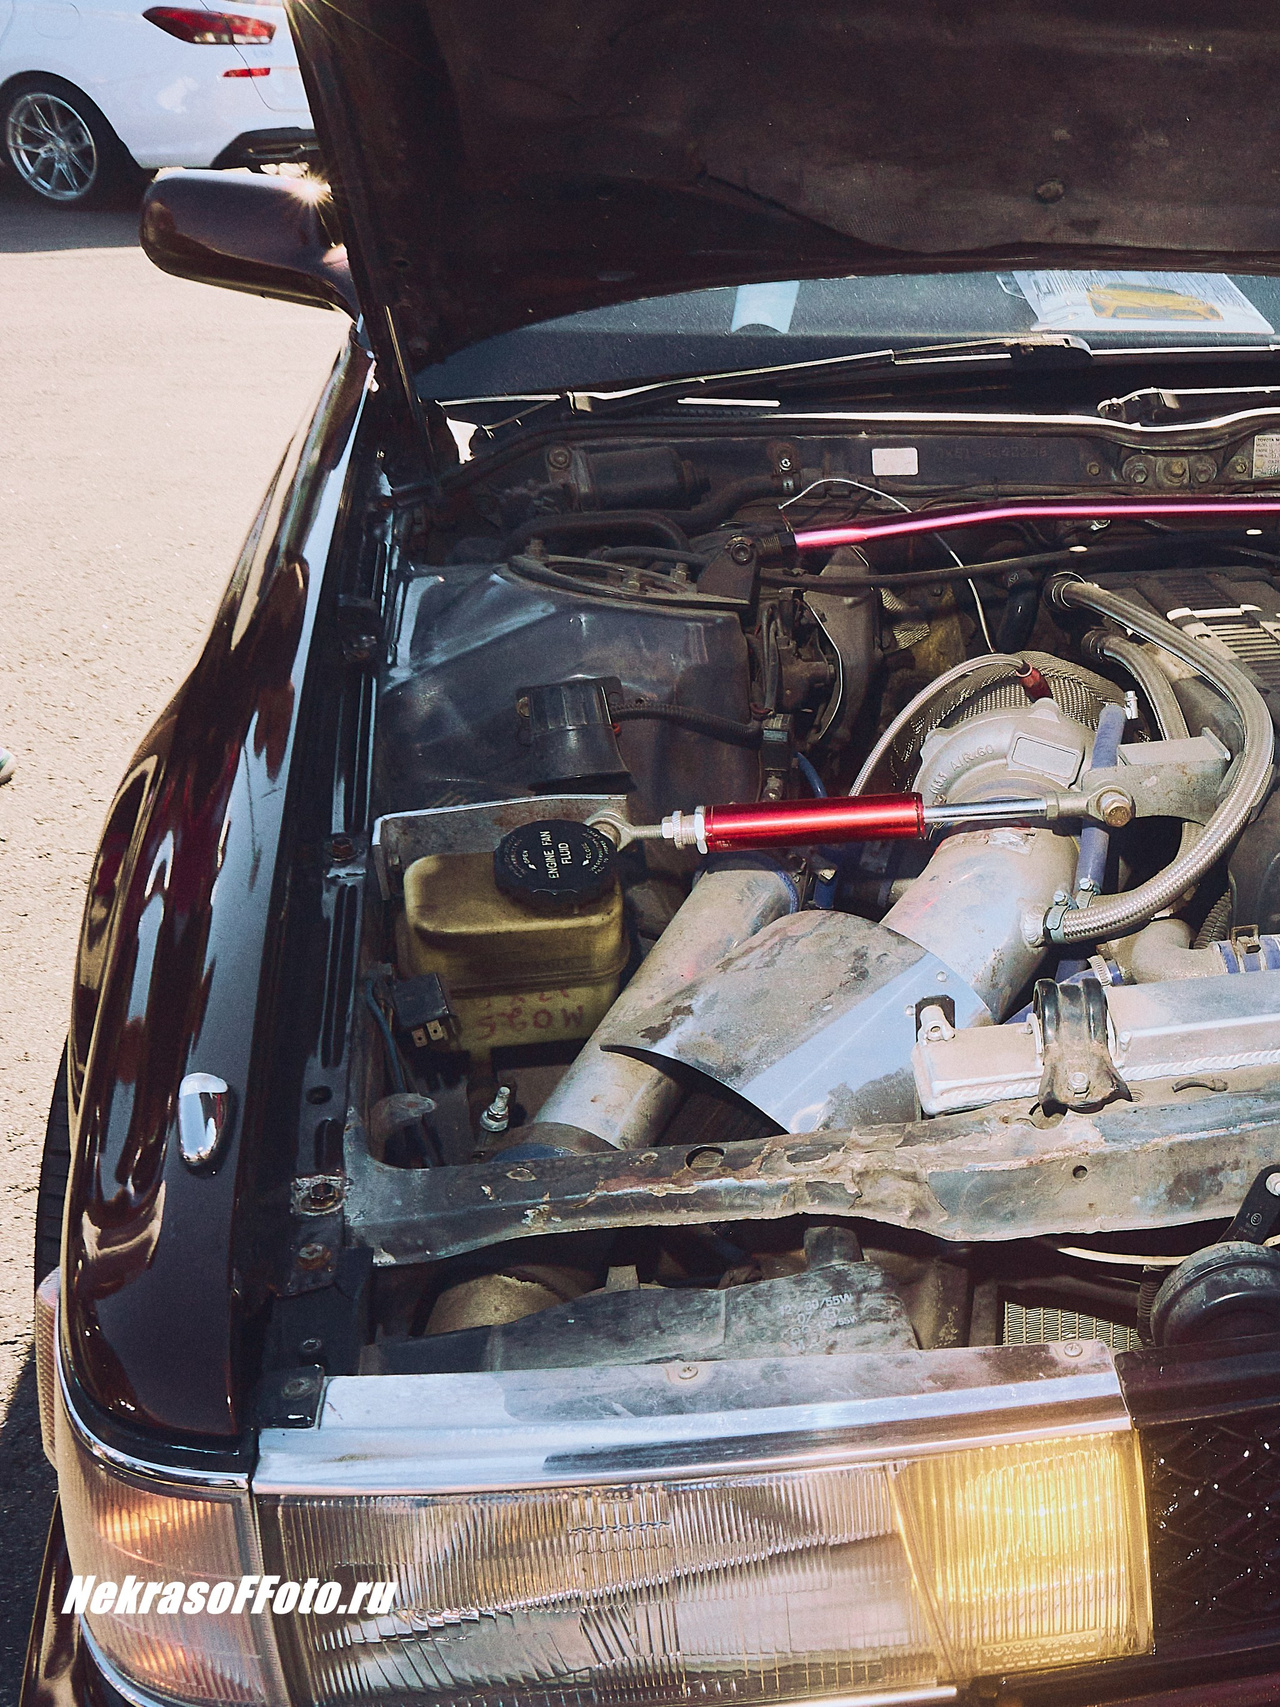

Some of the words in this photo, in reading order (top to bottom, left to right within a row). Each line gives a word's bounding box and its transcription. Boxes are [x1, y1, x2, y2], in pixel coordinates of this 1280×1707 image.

[539, 830, 553, 846] FAN
[543, 849, 560, 879] ENGINE
[557, 842, 573, 865] FLUID
